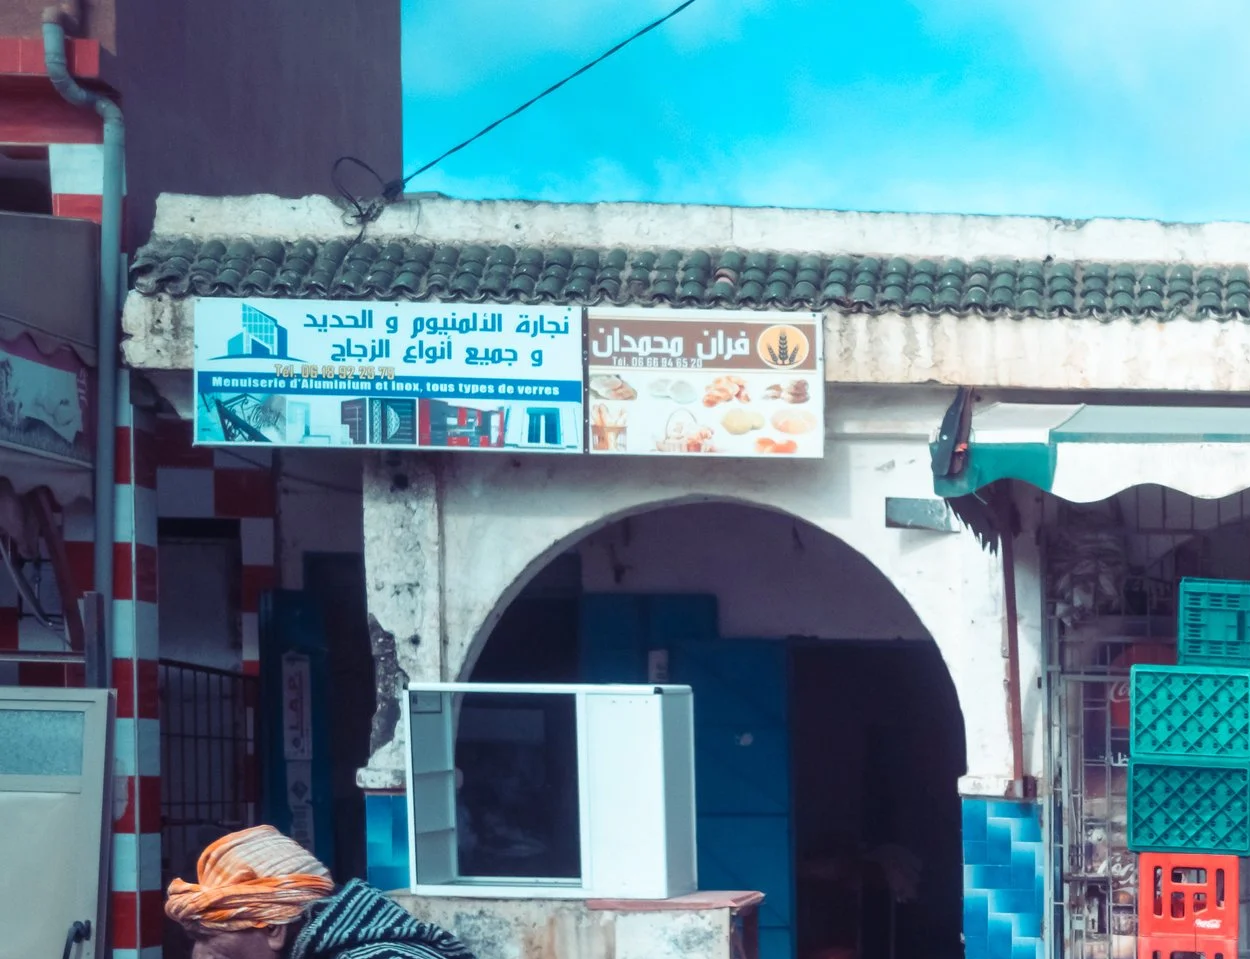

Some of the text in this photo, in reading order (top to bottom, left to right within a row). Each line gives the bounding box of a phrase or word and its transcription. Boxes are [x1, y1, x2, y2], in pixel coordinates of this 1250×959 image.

[303, 309, 570, 339] نجارة الألمنيوم و الحديد
[330, 335, 544, 367] و جميع أنواع الزجاج
[696, 329, 750, 361] فران
[301, 364, 318, 380] 06
[338, 365, 355, 380] 92
[632, 356, 644, 367] 06
[690, 358, 703, 369] 20
[211, 376, 560, 395] Menuiserie d'Aluminium et Inox, tous types de verres
